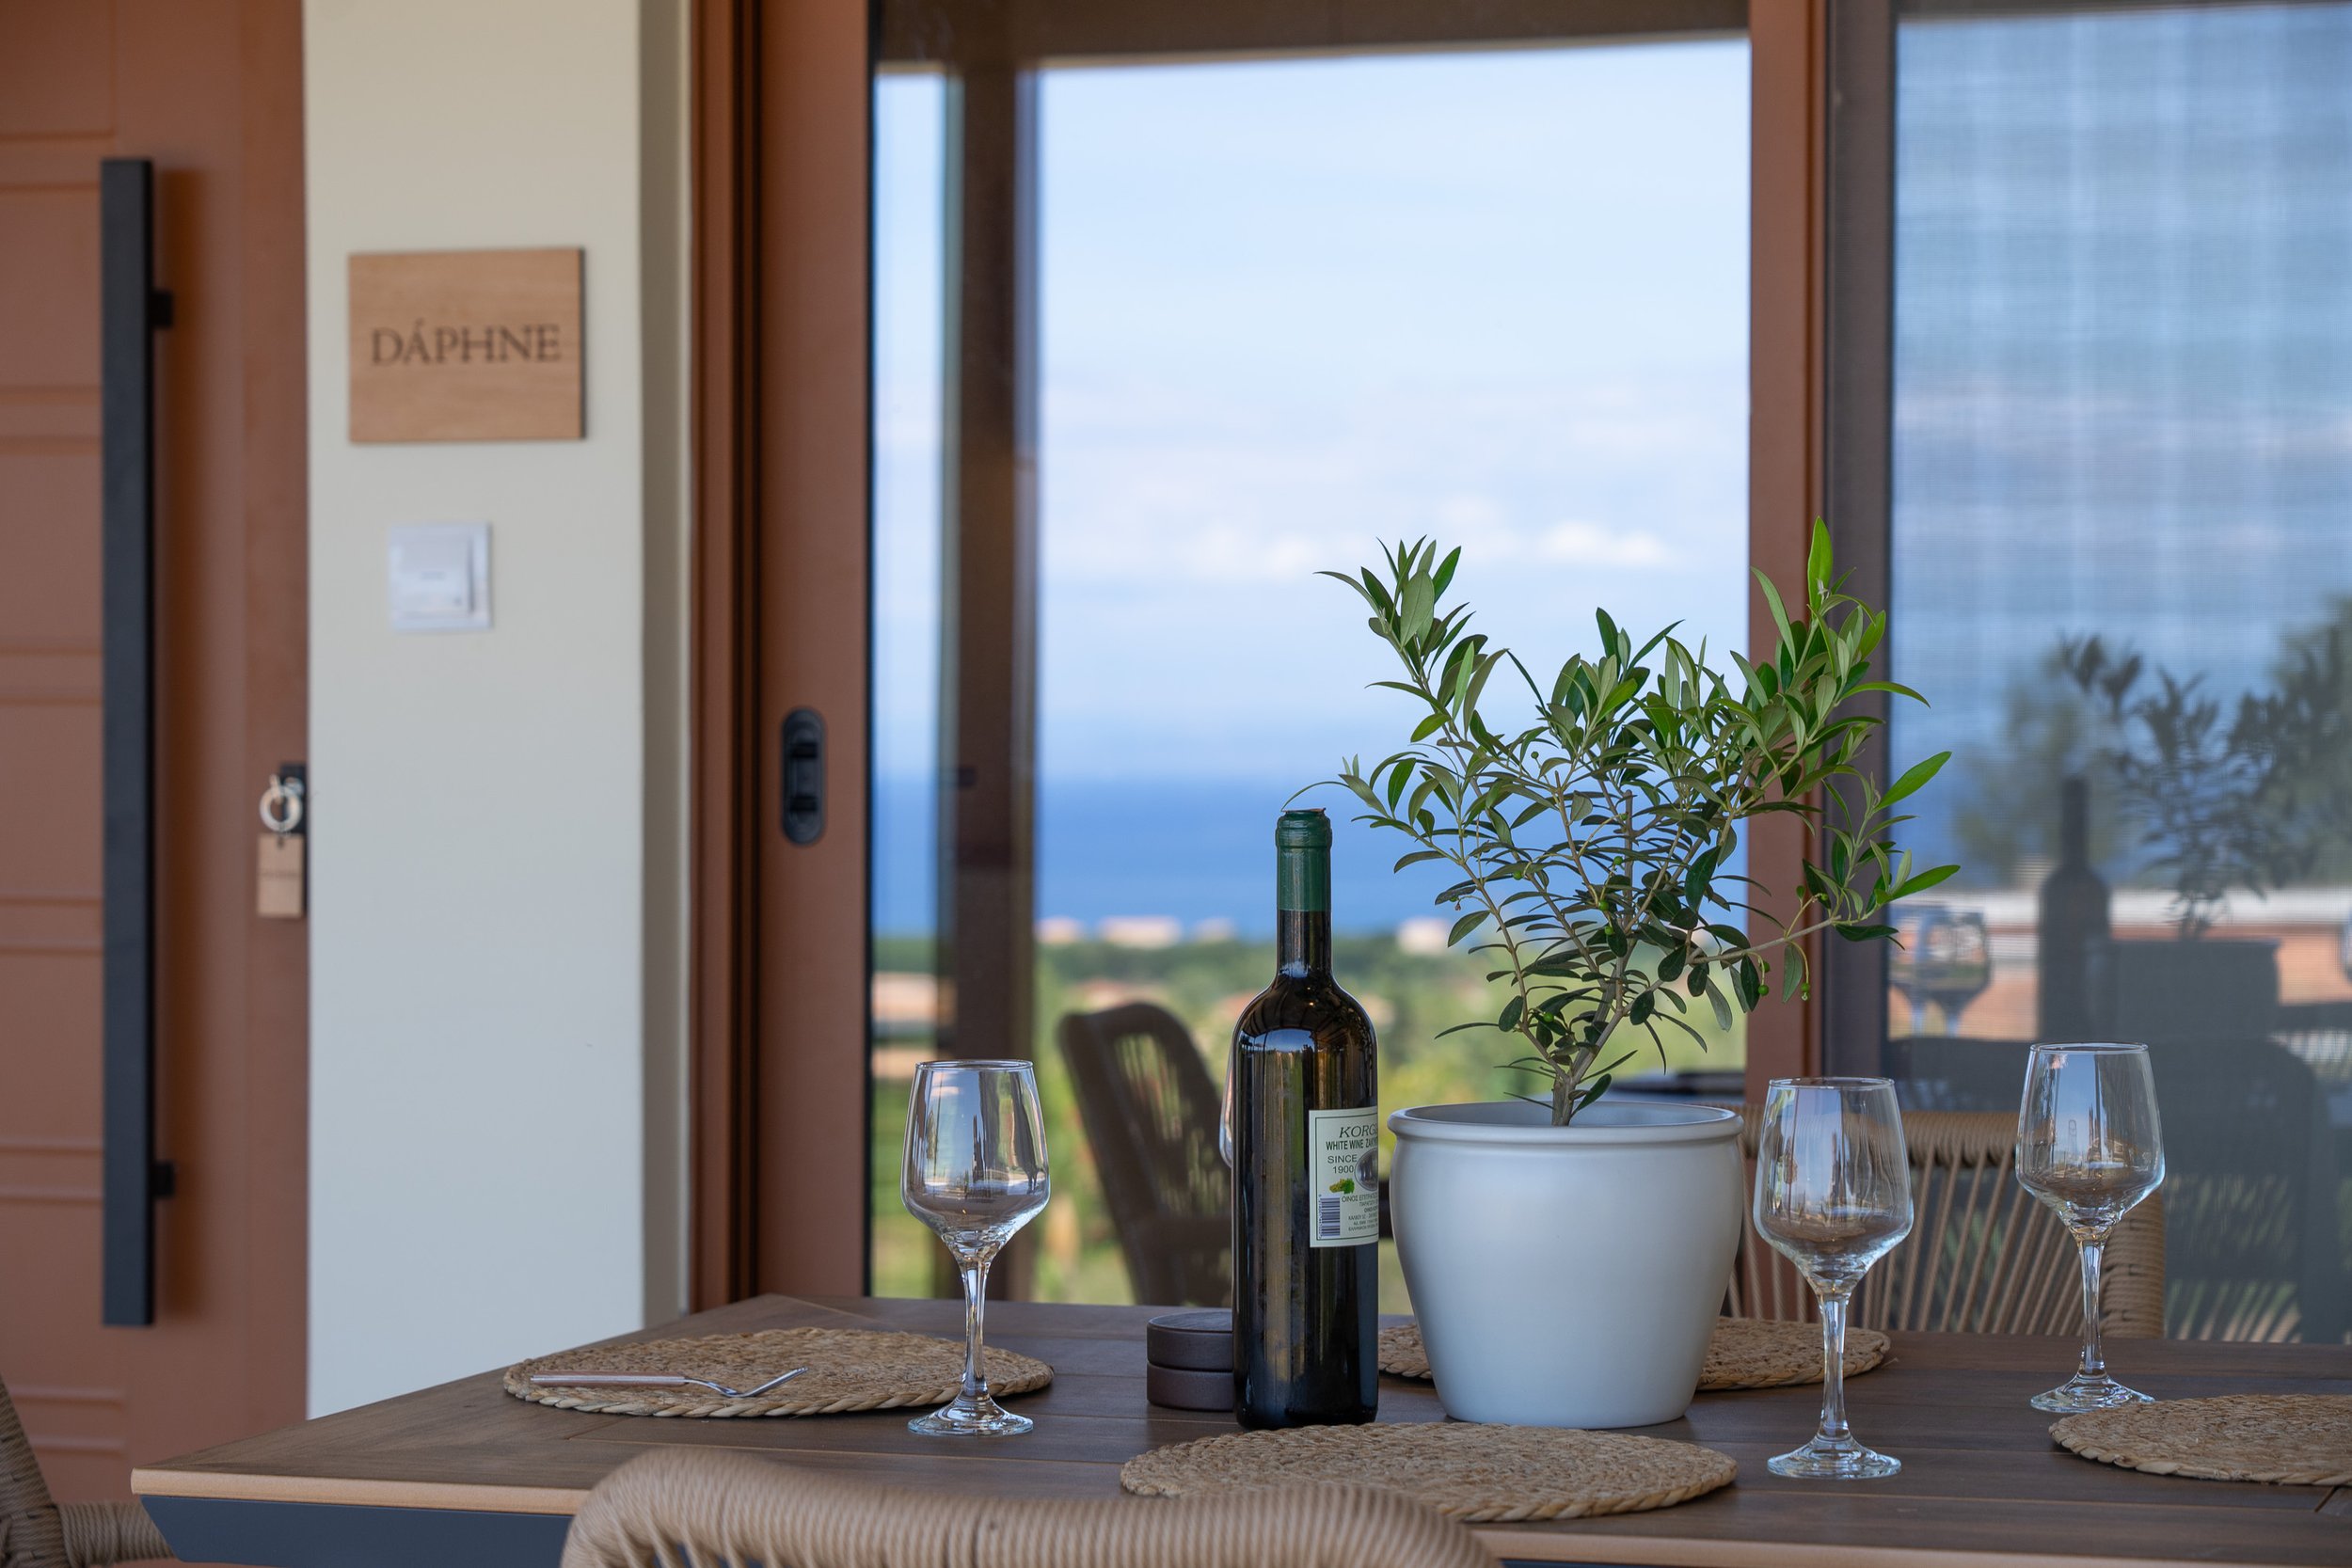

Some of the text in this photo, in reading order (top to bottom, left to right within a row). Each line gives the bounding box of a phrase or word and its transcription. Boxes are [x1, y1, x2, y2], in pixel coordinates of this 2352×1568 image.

[371, 317, 562, 366] DÁPHNE
[1326, 1141, 1348, 1150] WHITE
[1349, 1139, 1364, 1149] WINE
[1327, 1154, 1358, 1164] SINCE
[1333, 1165, 1355, 1174] 1900
